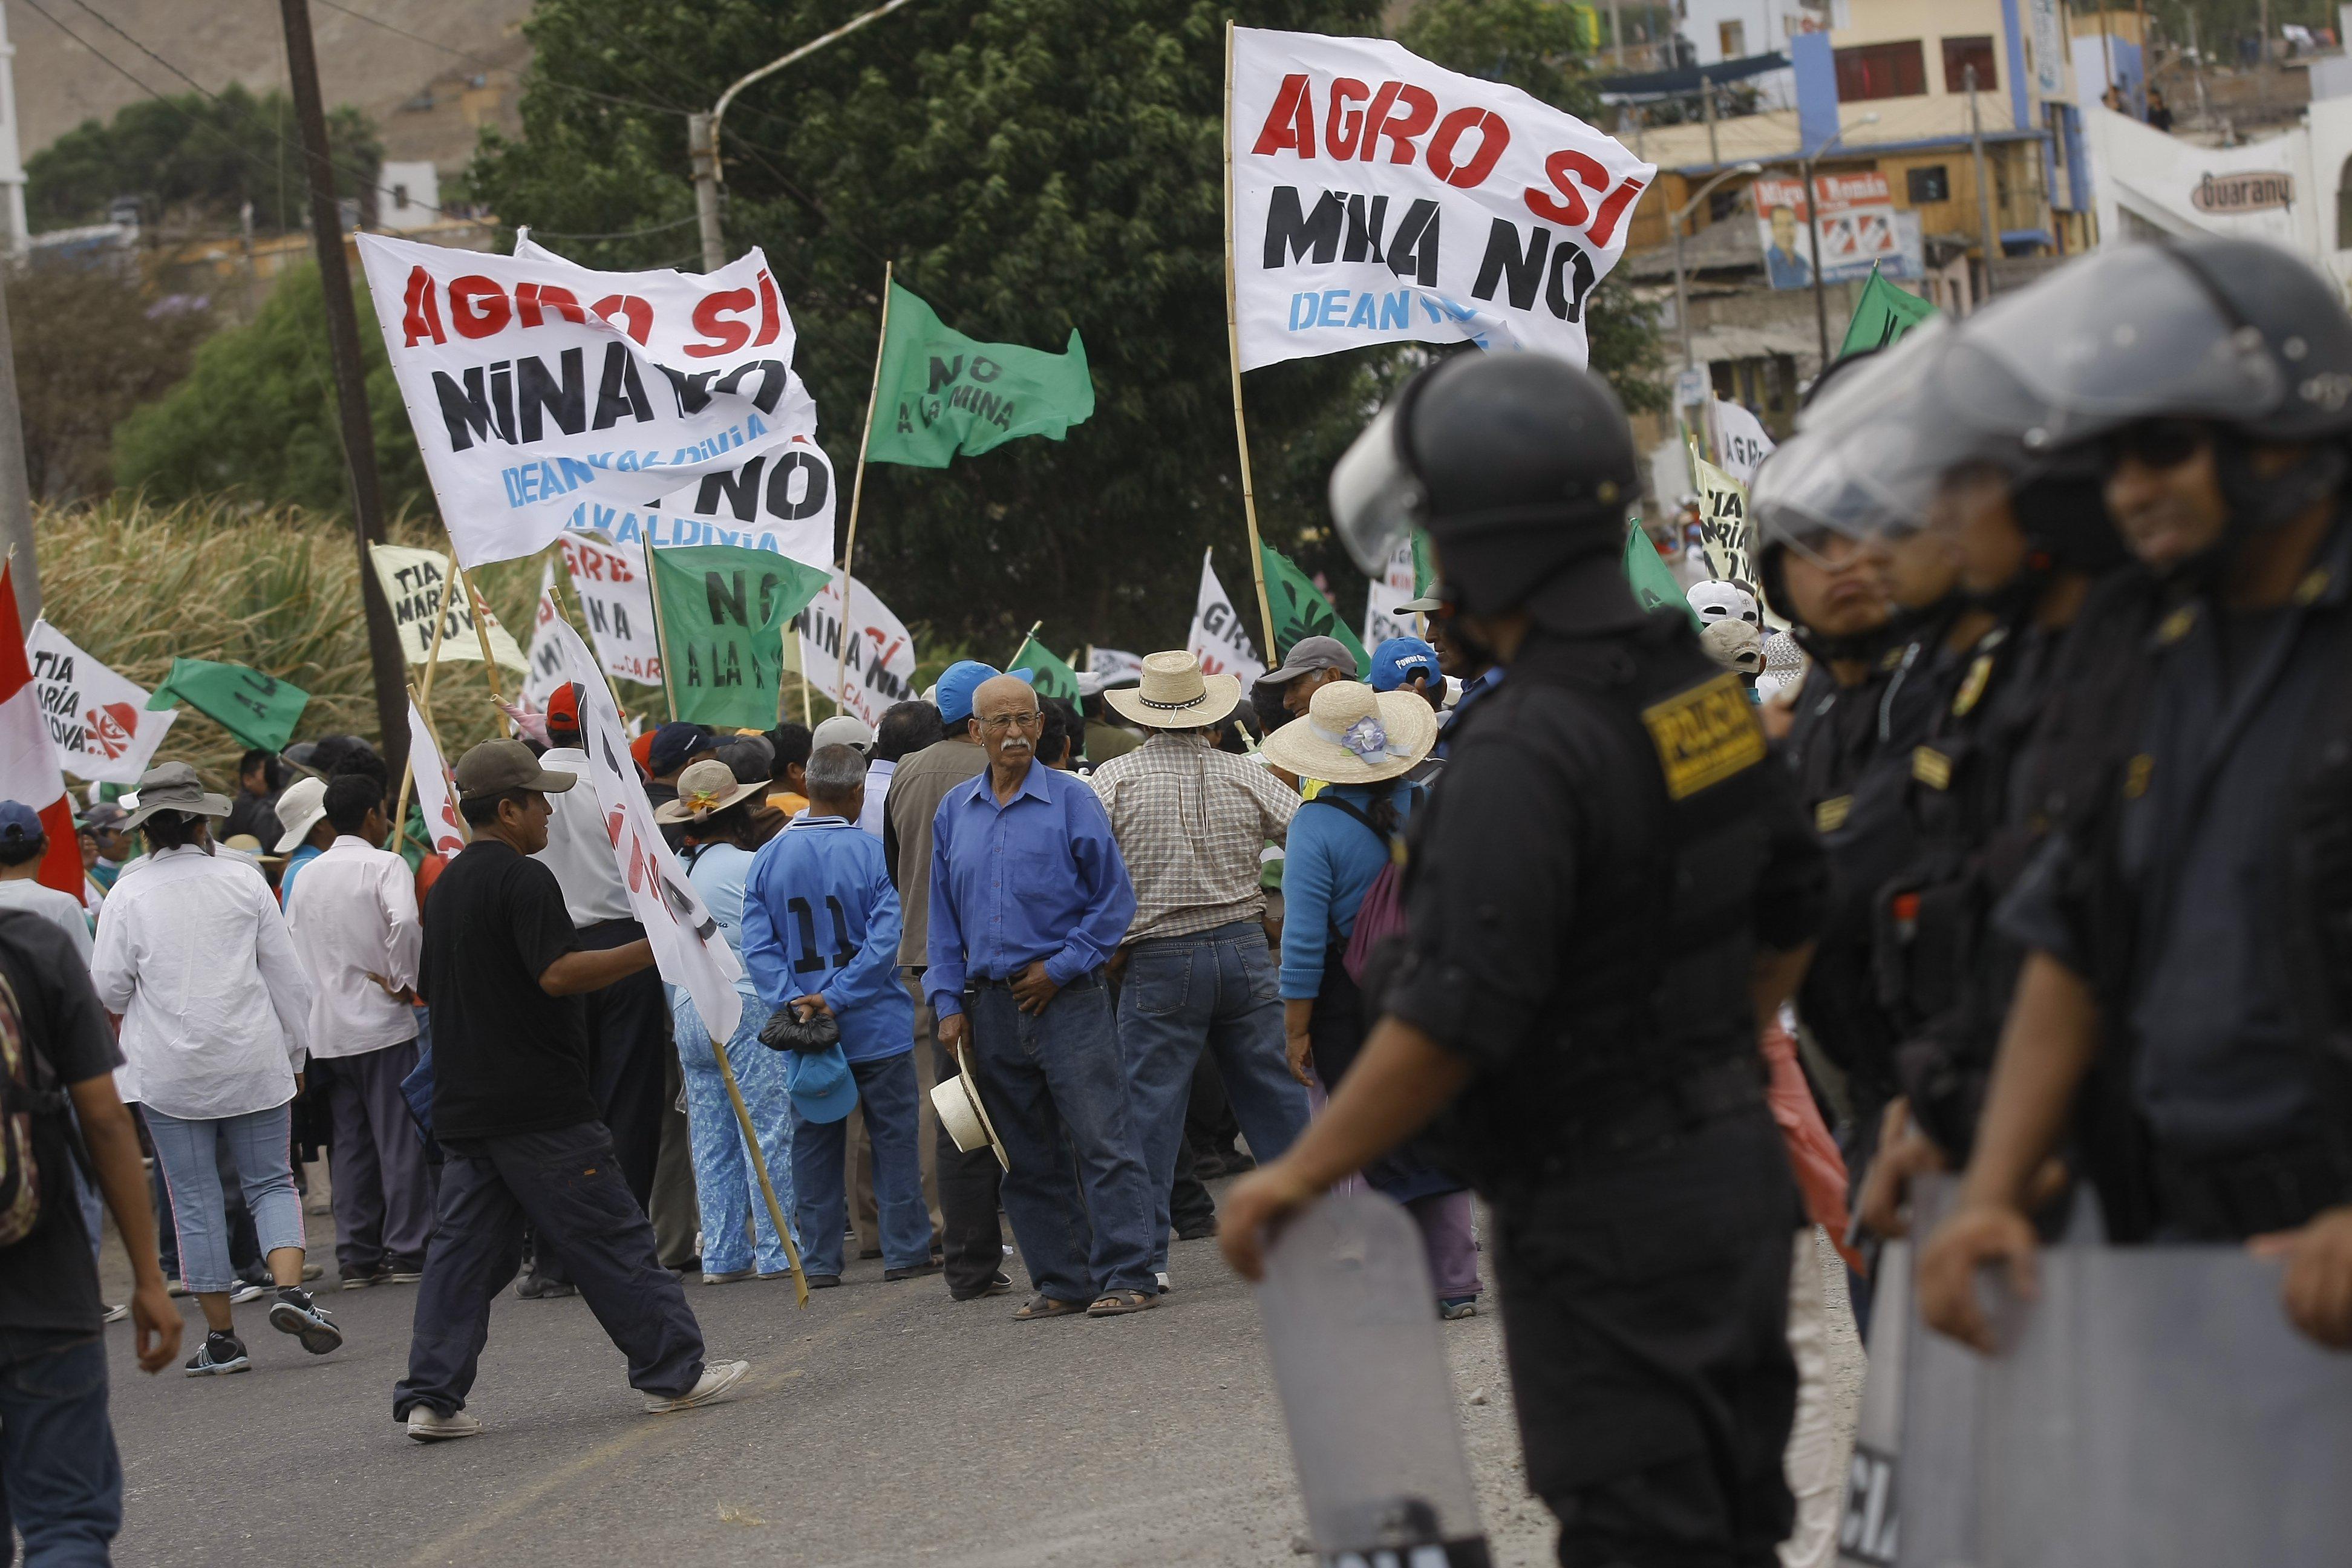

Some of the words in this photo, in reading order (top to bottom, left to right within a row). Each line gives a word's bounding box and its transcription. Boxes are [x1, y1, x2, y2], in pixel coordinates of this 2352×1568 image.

[1251, 74, 1511, 189] AGRO
[1471, 217, 1596, 324] NO
[1289, 289, 1411, 332] DEAN
[928, 354, 1002, 395] NO
[694, 452, 829, 523] NO
[394, 561, 443, 595] TIA
[34, 650, 74, 683] TIA
[788, 895, 860, 974] 11
